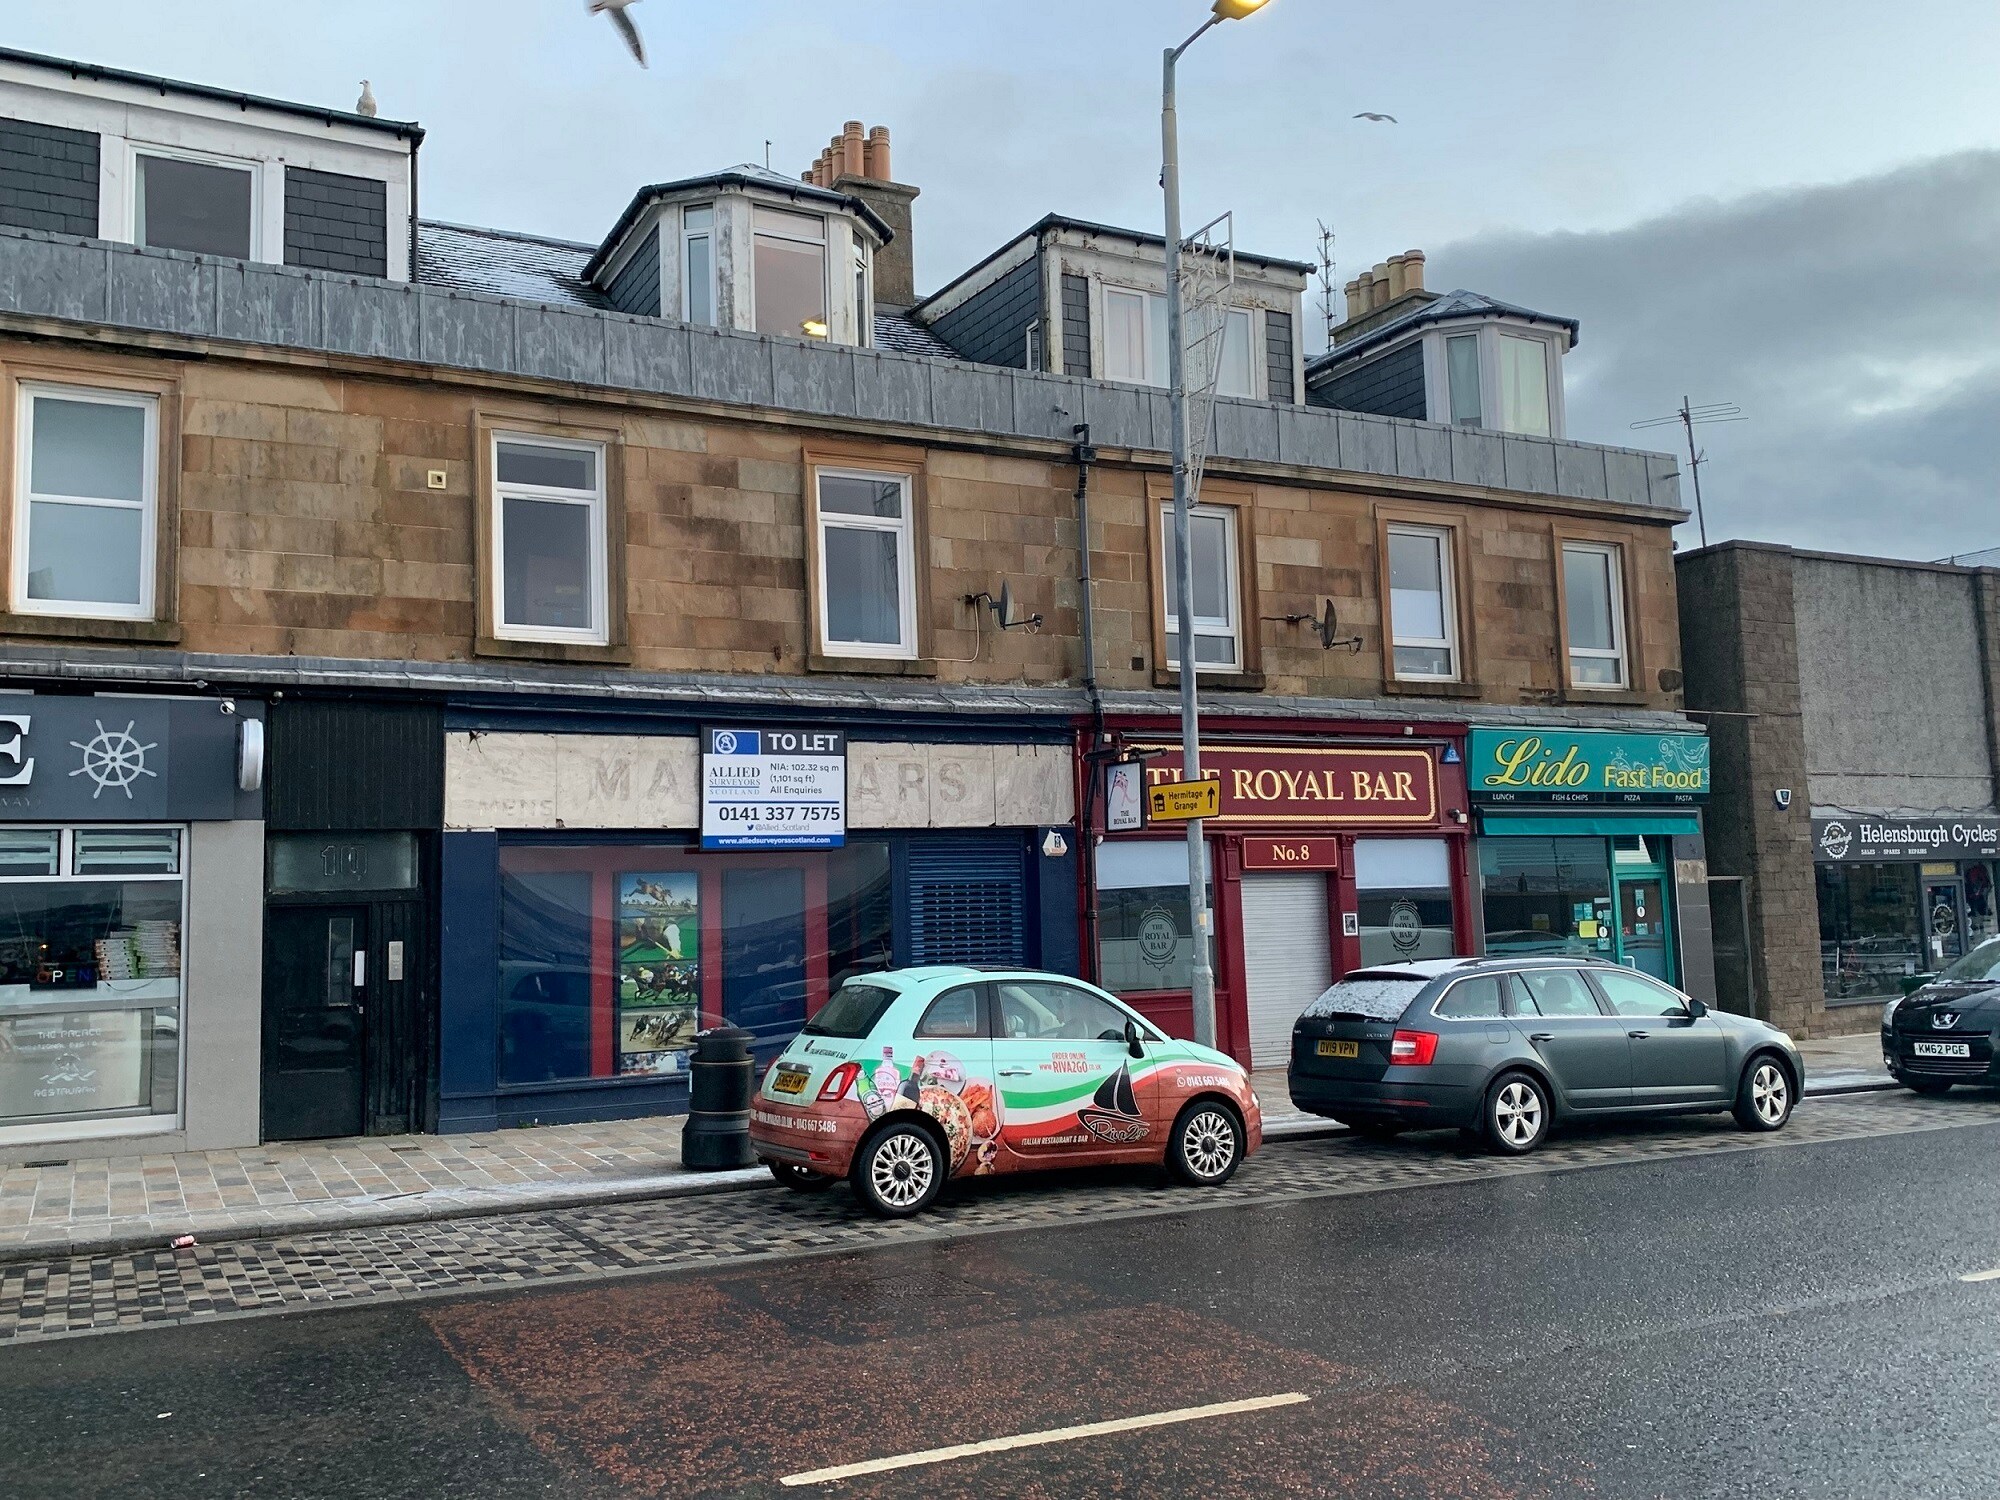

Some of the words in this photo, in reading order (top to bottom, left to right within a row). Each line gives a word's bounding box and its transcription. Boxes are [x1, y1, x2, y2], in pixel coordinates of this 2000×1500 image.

[768, 733, 796, 750] TO
[802, 734, 838, 751] LET
[1484, 735, 1591, 787] Lido
[709, 767, 761, 777] ALLIED
[770, 763, 789, 771] NIA:
[791, 763, 818, 771] 102.32
[819, 764, 829, 772] sq
[805, 774, 816, 783] ft)
[1603, 764, 1647, 788] Fast
[1651, 765, 1702, 788] Food
[709, 778, 761, 786] SURVEYORS
[1232, 768, 1344, 800] ROYAL
[1351, 770, 1417, 801] BAR
[770, 786, 782, 794] All
[784, 787, 823, 795] Enquiries
[1168, 789, 1204, 801] Hermitage
[1552, 793, 1568, 801] FISH
[1174, 801, 1198, 811] Grange
[719, 807, 760, 820] 0141
[765, 807, 794, 820] 337
[801, 807, 840, 821] 7575
[1860, 824, 1949, 847] Helensburgh
[1952, 824, 1997, 847] Cycles
[718, 837, 831, 845] www.alliedsurveyorsscotland.com
[1272, 845, 1310, 861] No.8
[1145, 932, 1169, 940] ROYAL
[1151, 942, 1167, 950] BAR
[37, 970, 90, 983] OPEN
[1340, 1044, 1354, 1054] VPN
[1918, 1044, 1943, 1054] KM62
[1945, 1044, 1965, 1055] PGE
[818, 1121, 837, 1133] 5486
[1041, 1135, 1073, 1145] RESTAURANT
[1078, 1135, 1089, 1143] BAR
